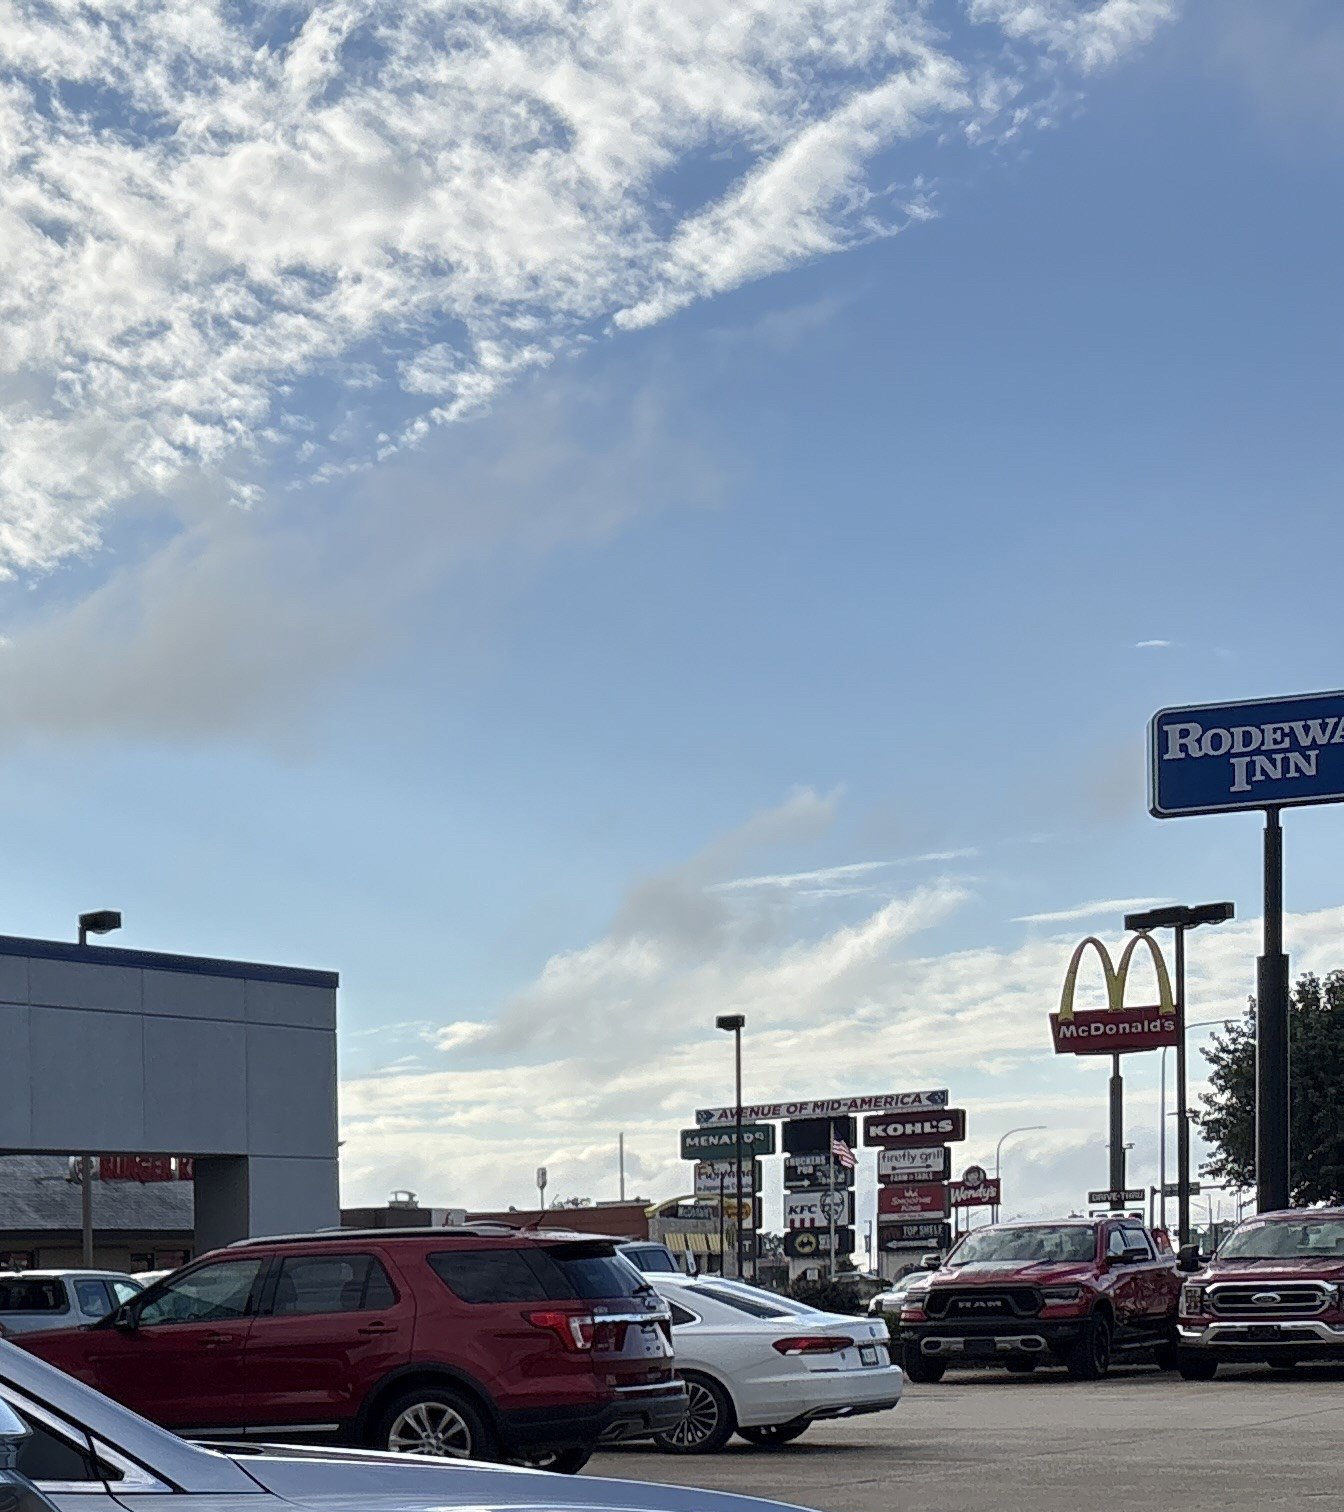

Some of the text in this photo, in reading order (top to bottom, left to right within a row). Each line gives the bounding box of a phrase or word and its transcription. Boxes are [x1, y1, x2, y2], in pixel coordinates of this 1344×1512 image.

[1230, 750, 1319, 792] INN
[1058, 1018, 1175, 1039] McDonald's
[717, 1093, 923, 1121] AVENUE OF MID-AMERICA
[869, 1119, 954, 1137] KOHL'S
[881, 1149, 943, 1164] firefly grill
[951, 1184, 998, 1204] Wendy's
[1092, 1191, 1143, 1201] DRIVE-THRU
[788, 1204, 817, 1215] KFC
[958, 1300, 1002, 1309] RAM
